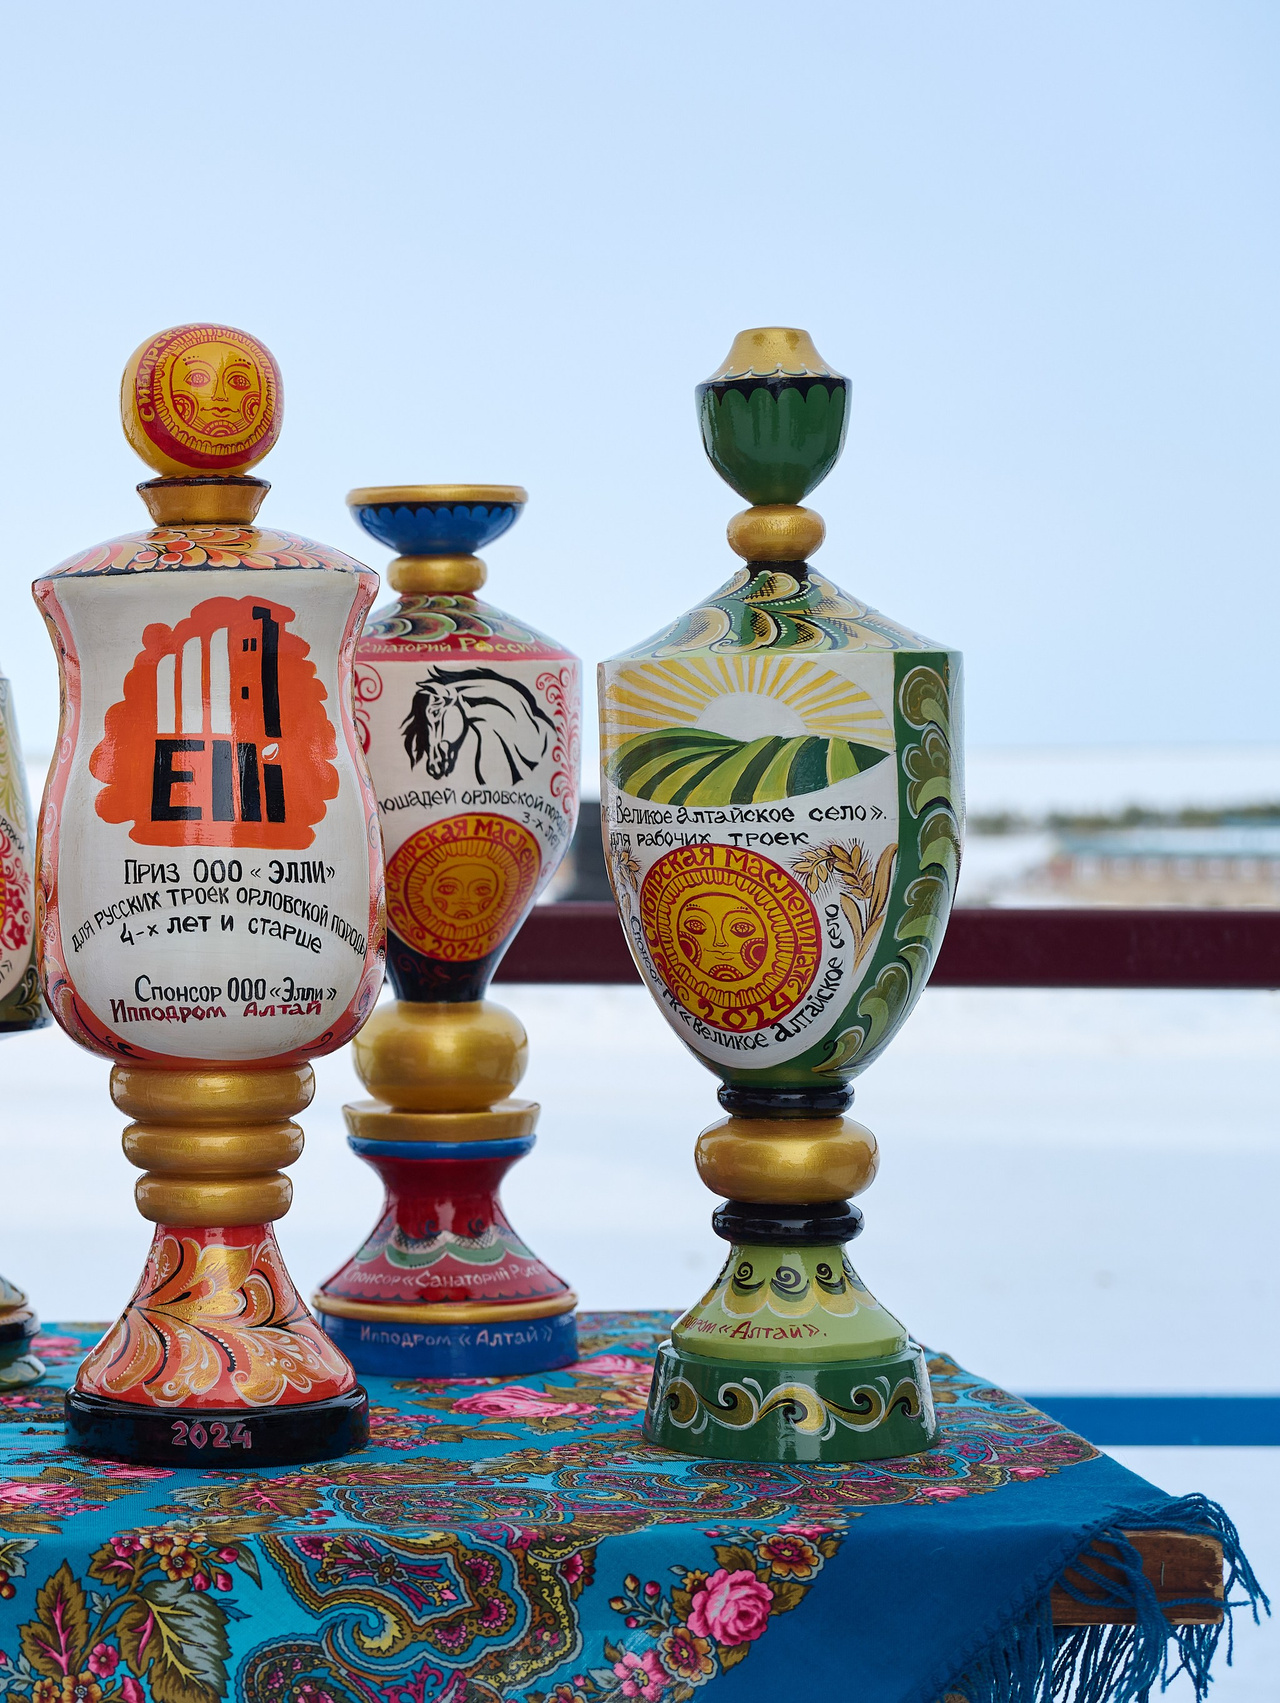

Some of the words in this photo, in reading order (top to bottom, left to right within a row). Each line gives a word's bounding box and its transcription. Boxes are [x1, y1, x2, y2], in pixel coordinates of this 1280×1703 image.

[431, 939, 483, 959] 2024
[109, 999, 227, 1024] Ипподром
[243, 1001, 322, 1019] Алтай
[698, 992, 795, 1026] 2024
[171, 1420, 252, 1449] 2024
